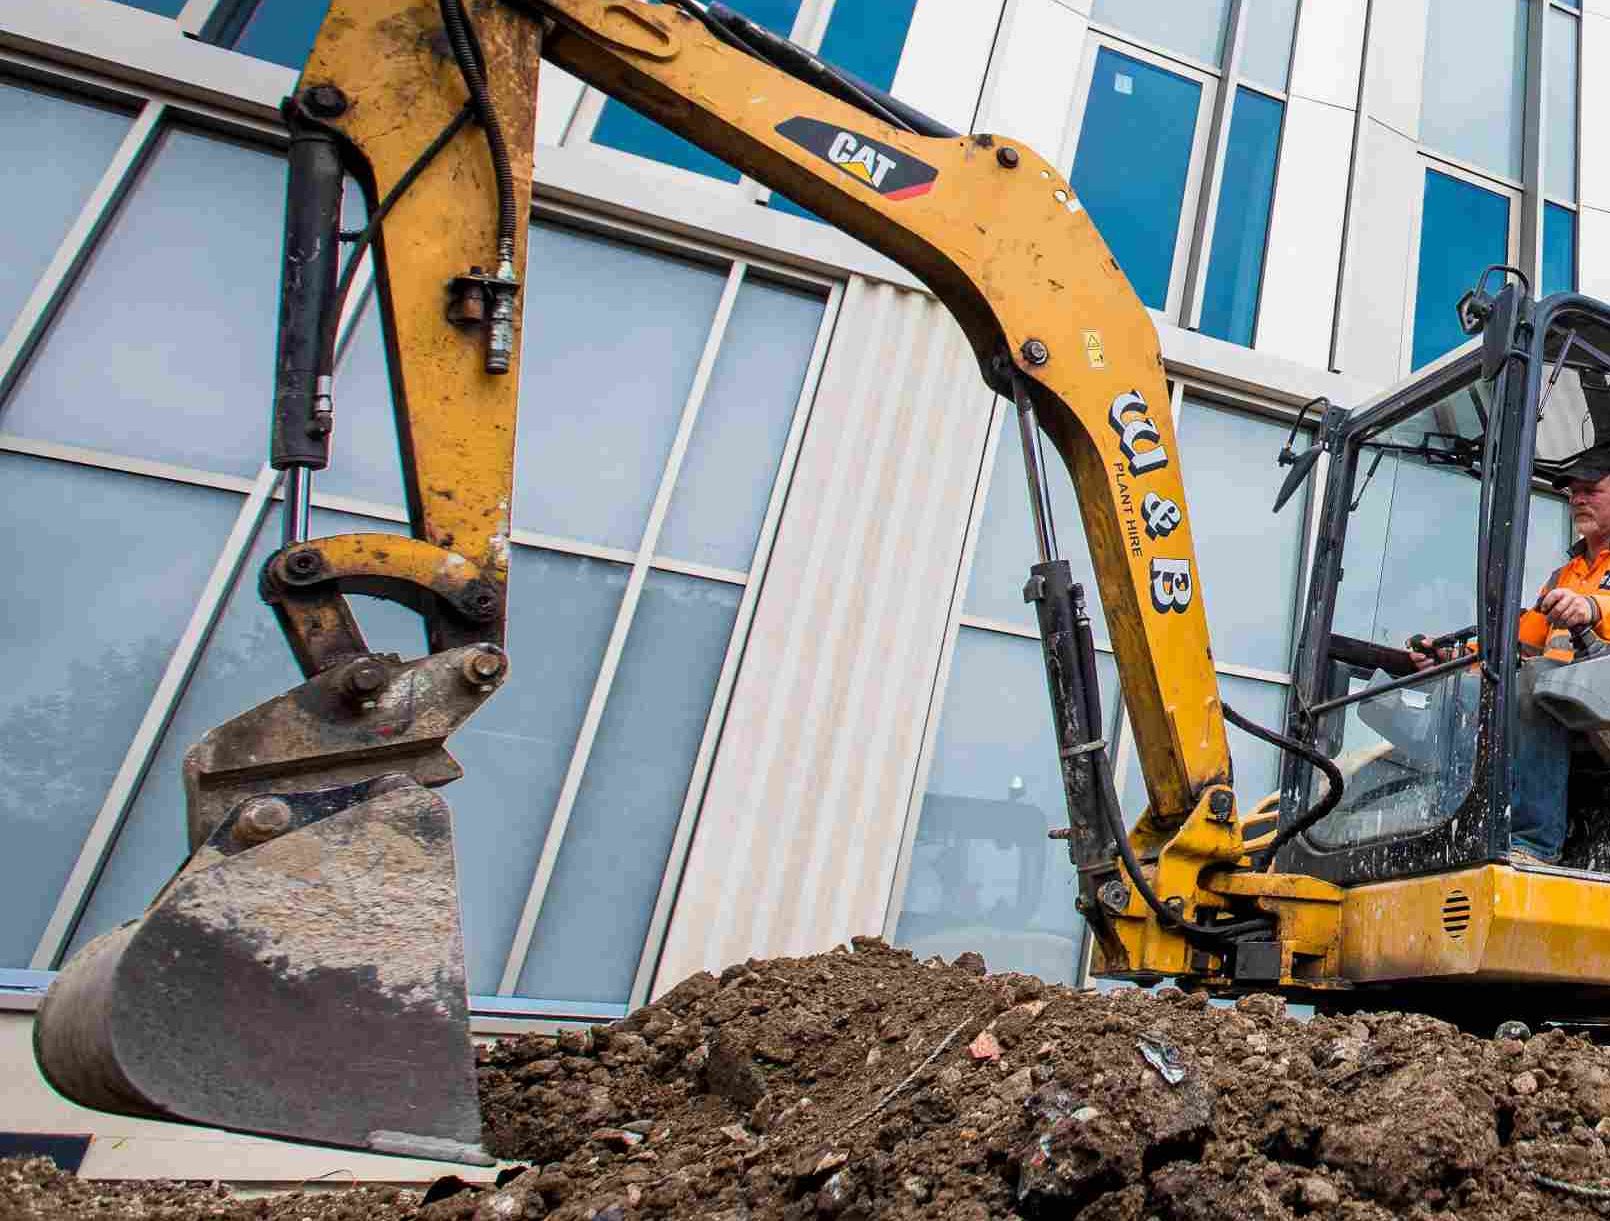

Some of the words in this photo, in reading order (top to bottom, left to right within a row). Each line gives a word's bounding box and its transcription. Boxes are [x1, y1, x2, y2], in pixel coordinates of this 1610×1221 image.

[827, 131, 897, 188] CAT
[1112, 462, 1133, 515] PLANT
[1125, 520, 1144, 559] HIRE
[1140, 492, 1182, 541] &
[1150, 557, 1193, 615] B
